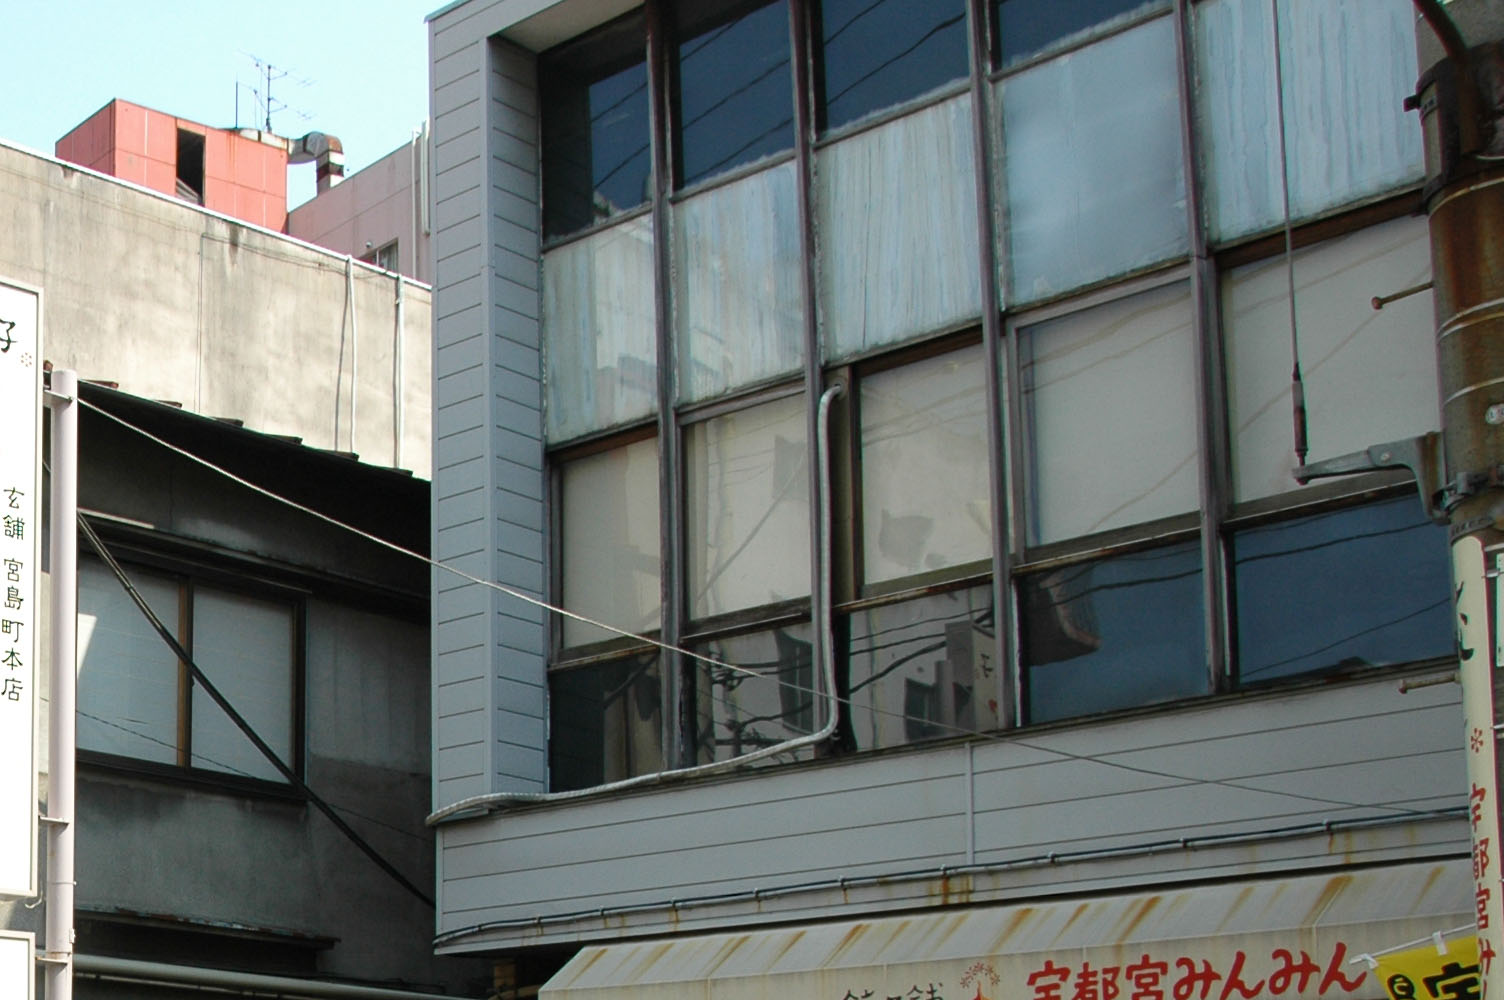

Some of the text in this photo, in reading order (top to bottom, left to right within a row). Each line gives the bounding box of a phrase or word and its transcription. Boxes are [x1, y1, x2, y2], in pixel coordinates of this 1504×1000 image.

[1, 557, 25, 702] 宮島町本店
